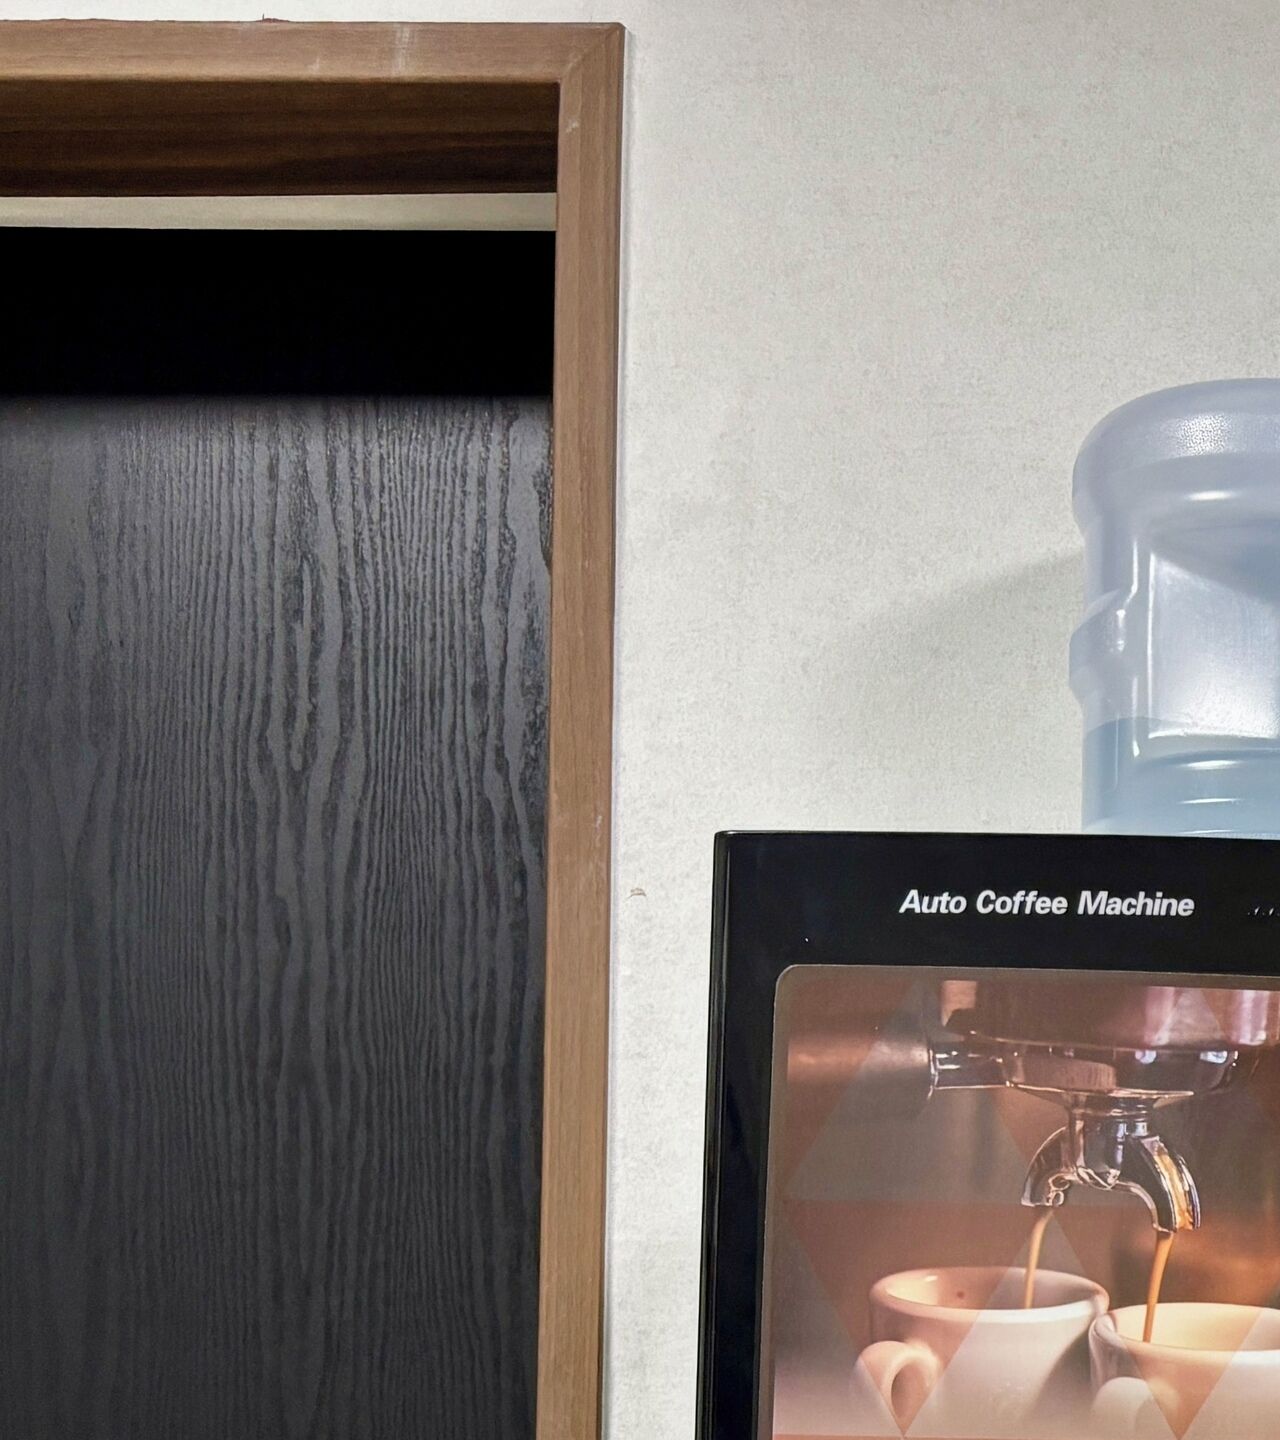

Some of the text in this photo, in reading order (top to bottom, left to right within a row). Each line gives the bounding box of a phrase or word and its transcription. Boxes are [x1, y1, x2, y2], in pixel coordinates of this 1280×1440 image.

[899, 889, 1195, 919] Auto Coffee Machine
